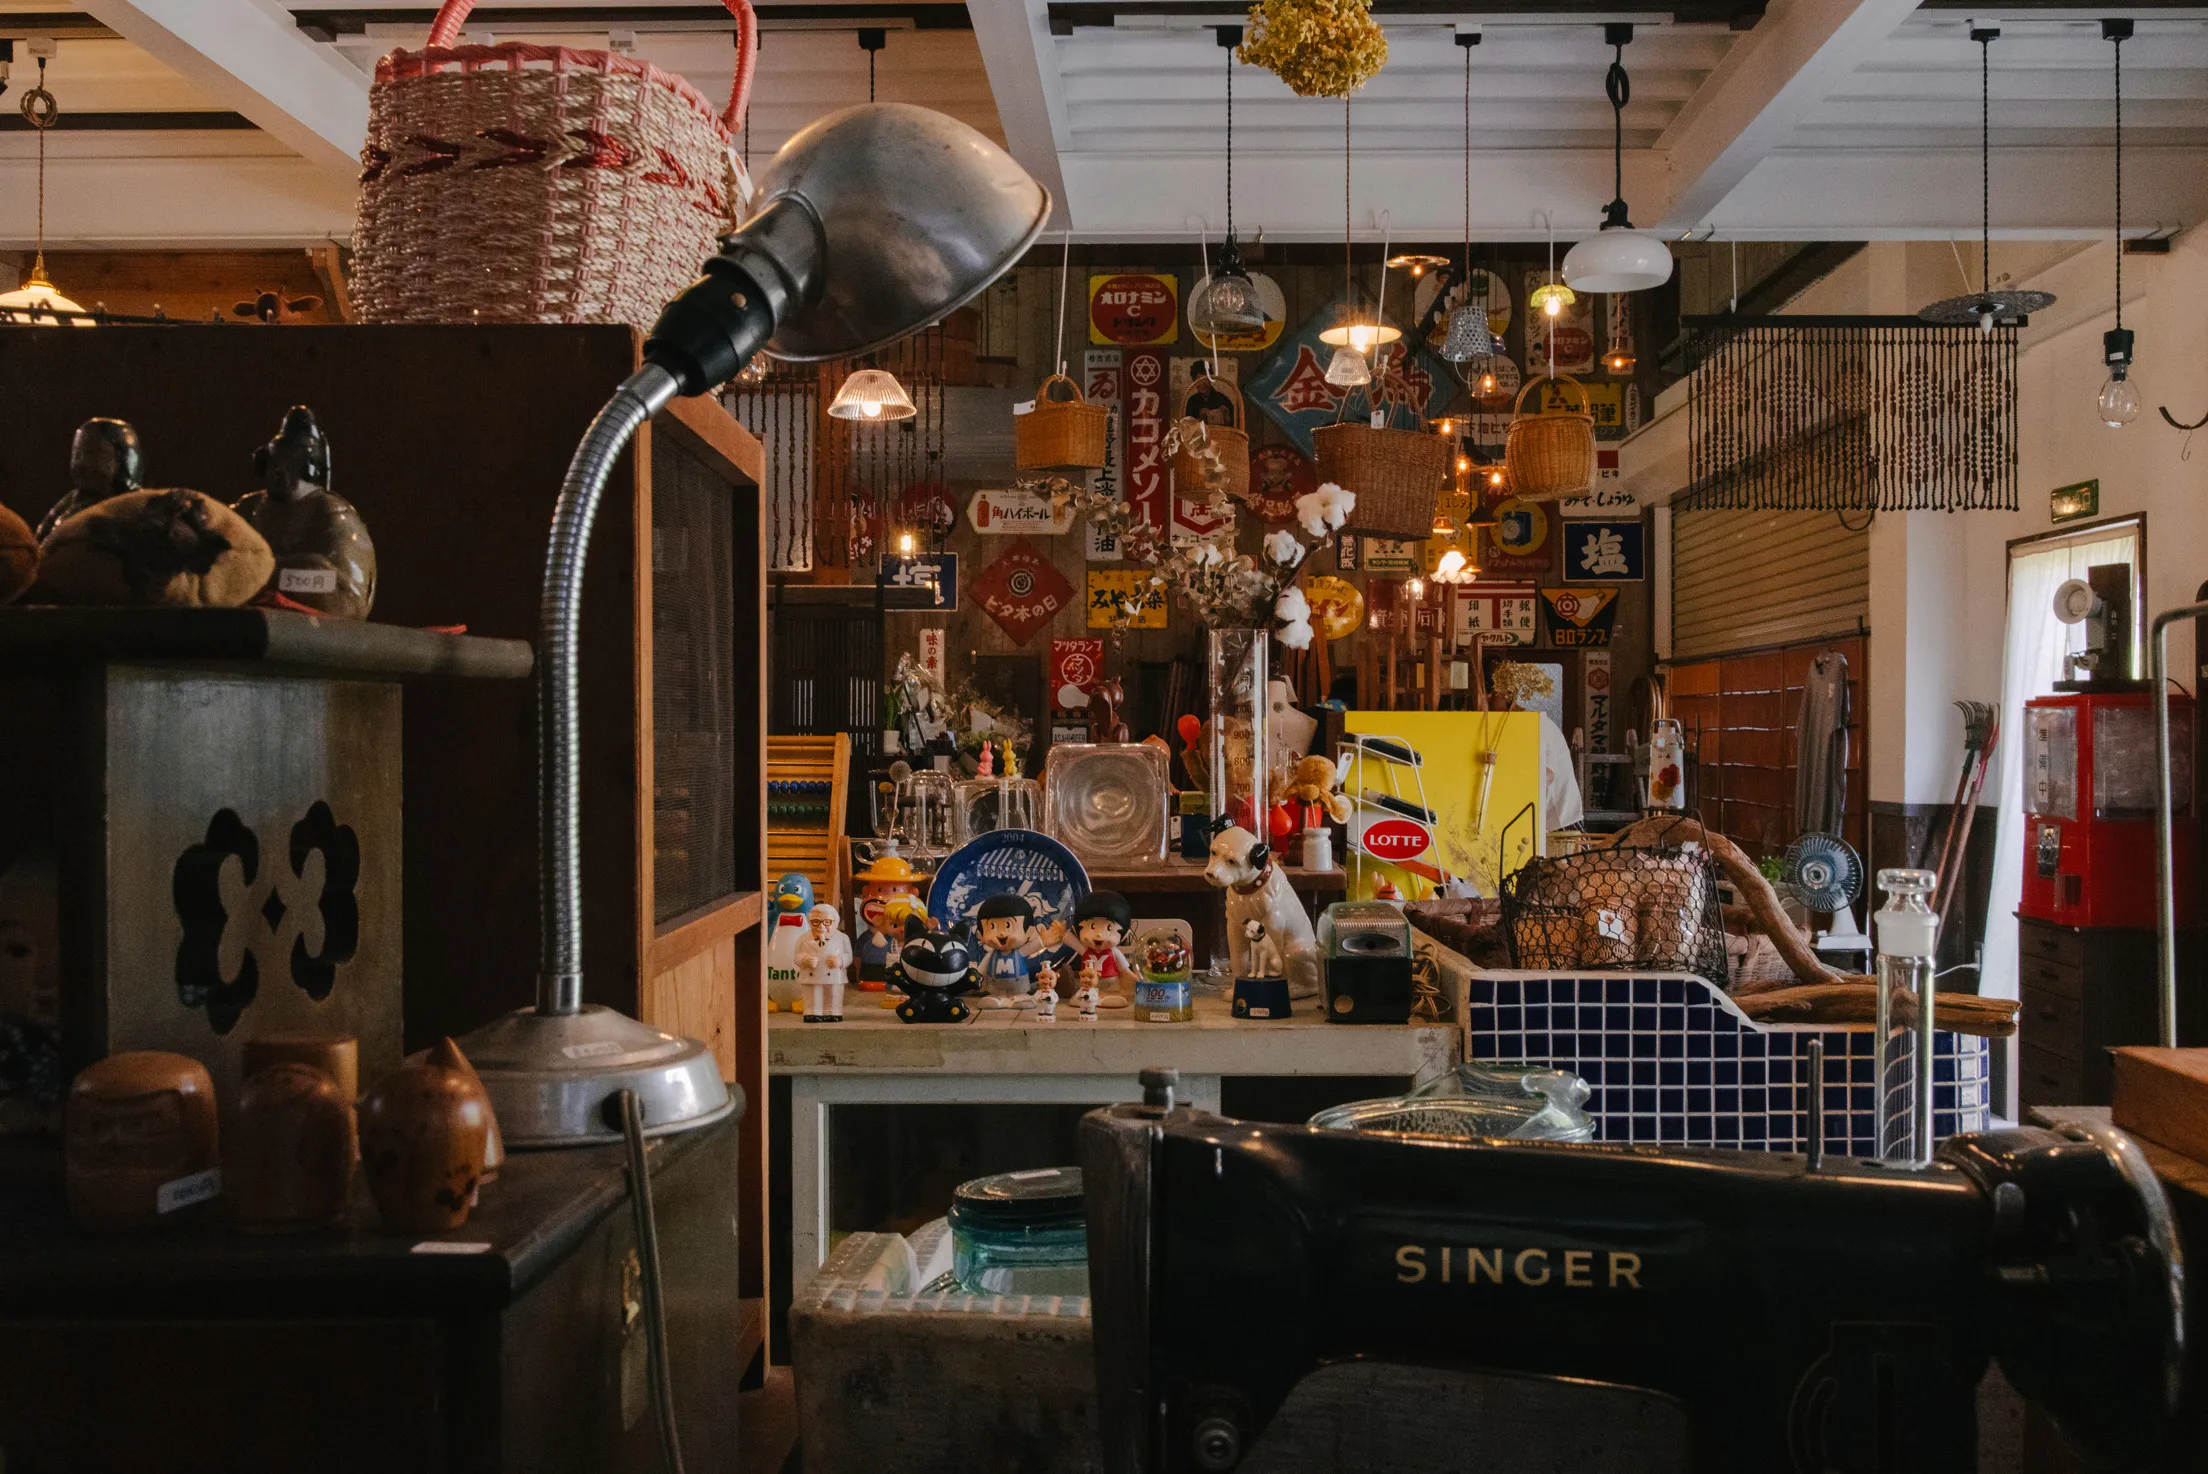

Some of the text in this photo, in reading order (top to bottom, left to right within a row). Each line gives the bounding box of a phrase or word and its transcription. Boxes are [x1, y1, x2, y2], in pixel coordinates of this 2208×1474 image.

[1101, 291, 1166, 304] オロナミン
[992, 505, 1050, 520] 角ハイボール
[1581, 528, 1629, 575] 塩
[1468, 600, 1480, 628] 印紙
[1519, 600, 1530, 628] 郵便
[1481, 634, 1511, 643] ヤクルト
[1555, 629, 1606, 645] 日立ランプ
[926, 634, 938, 669] 味の素
[1053, 641, 1103, 652] マツダランプ
[1234, 731, 1250, 740] 900
[1234, 757, 1250, 767] 800
[1002, 833, 1025, 843] 2004
[1369, 834, 1422, 847] LOTTE
[996, 957, 1013, 971] M
[1395, 1244, 1643, 1289] SINGER
